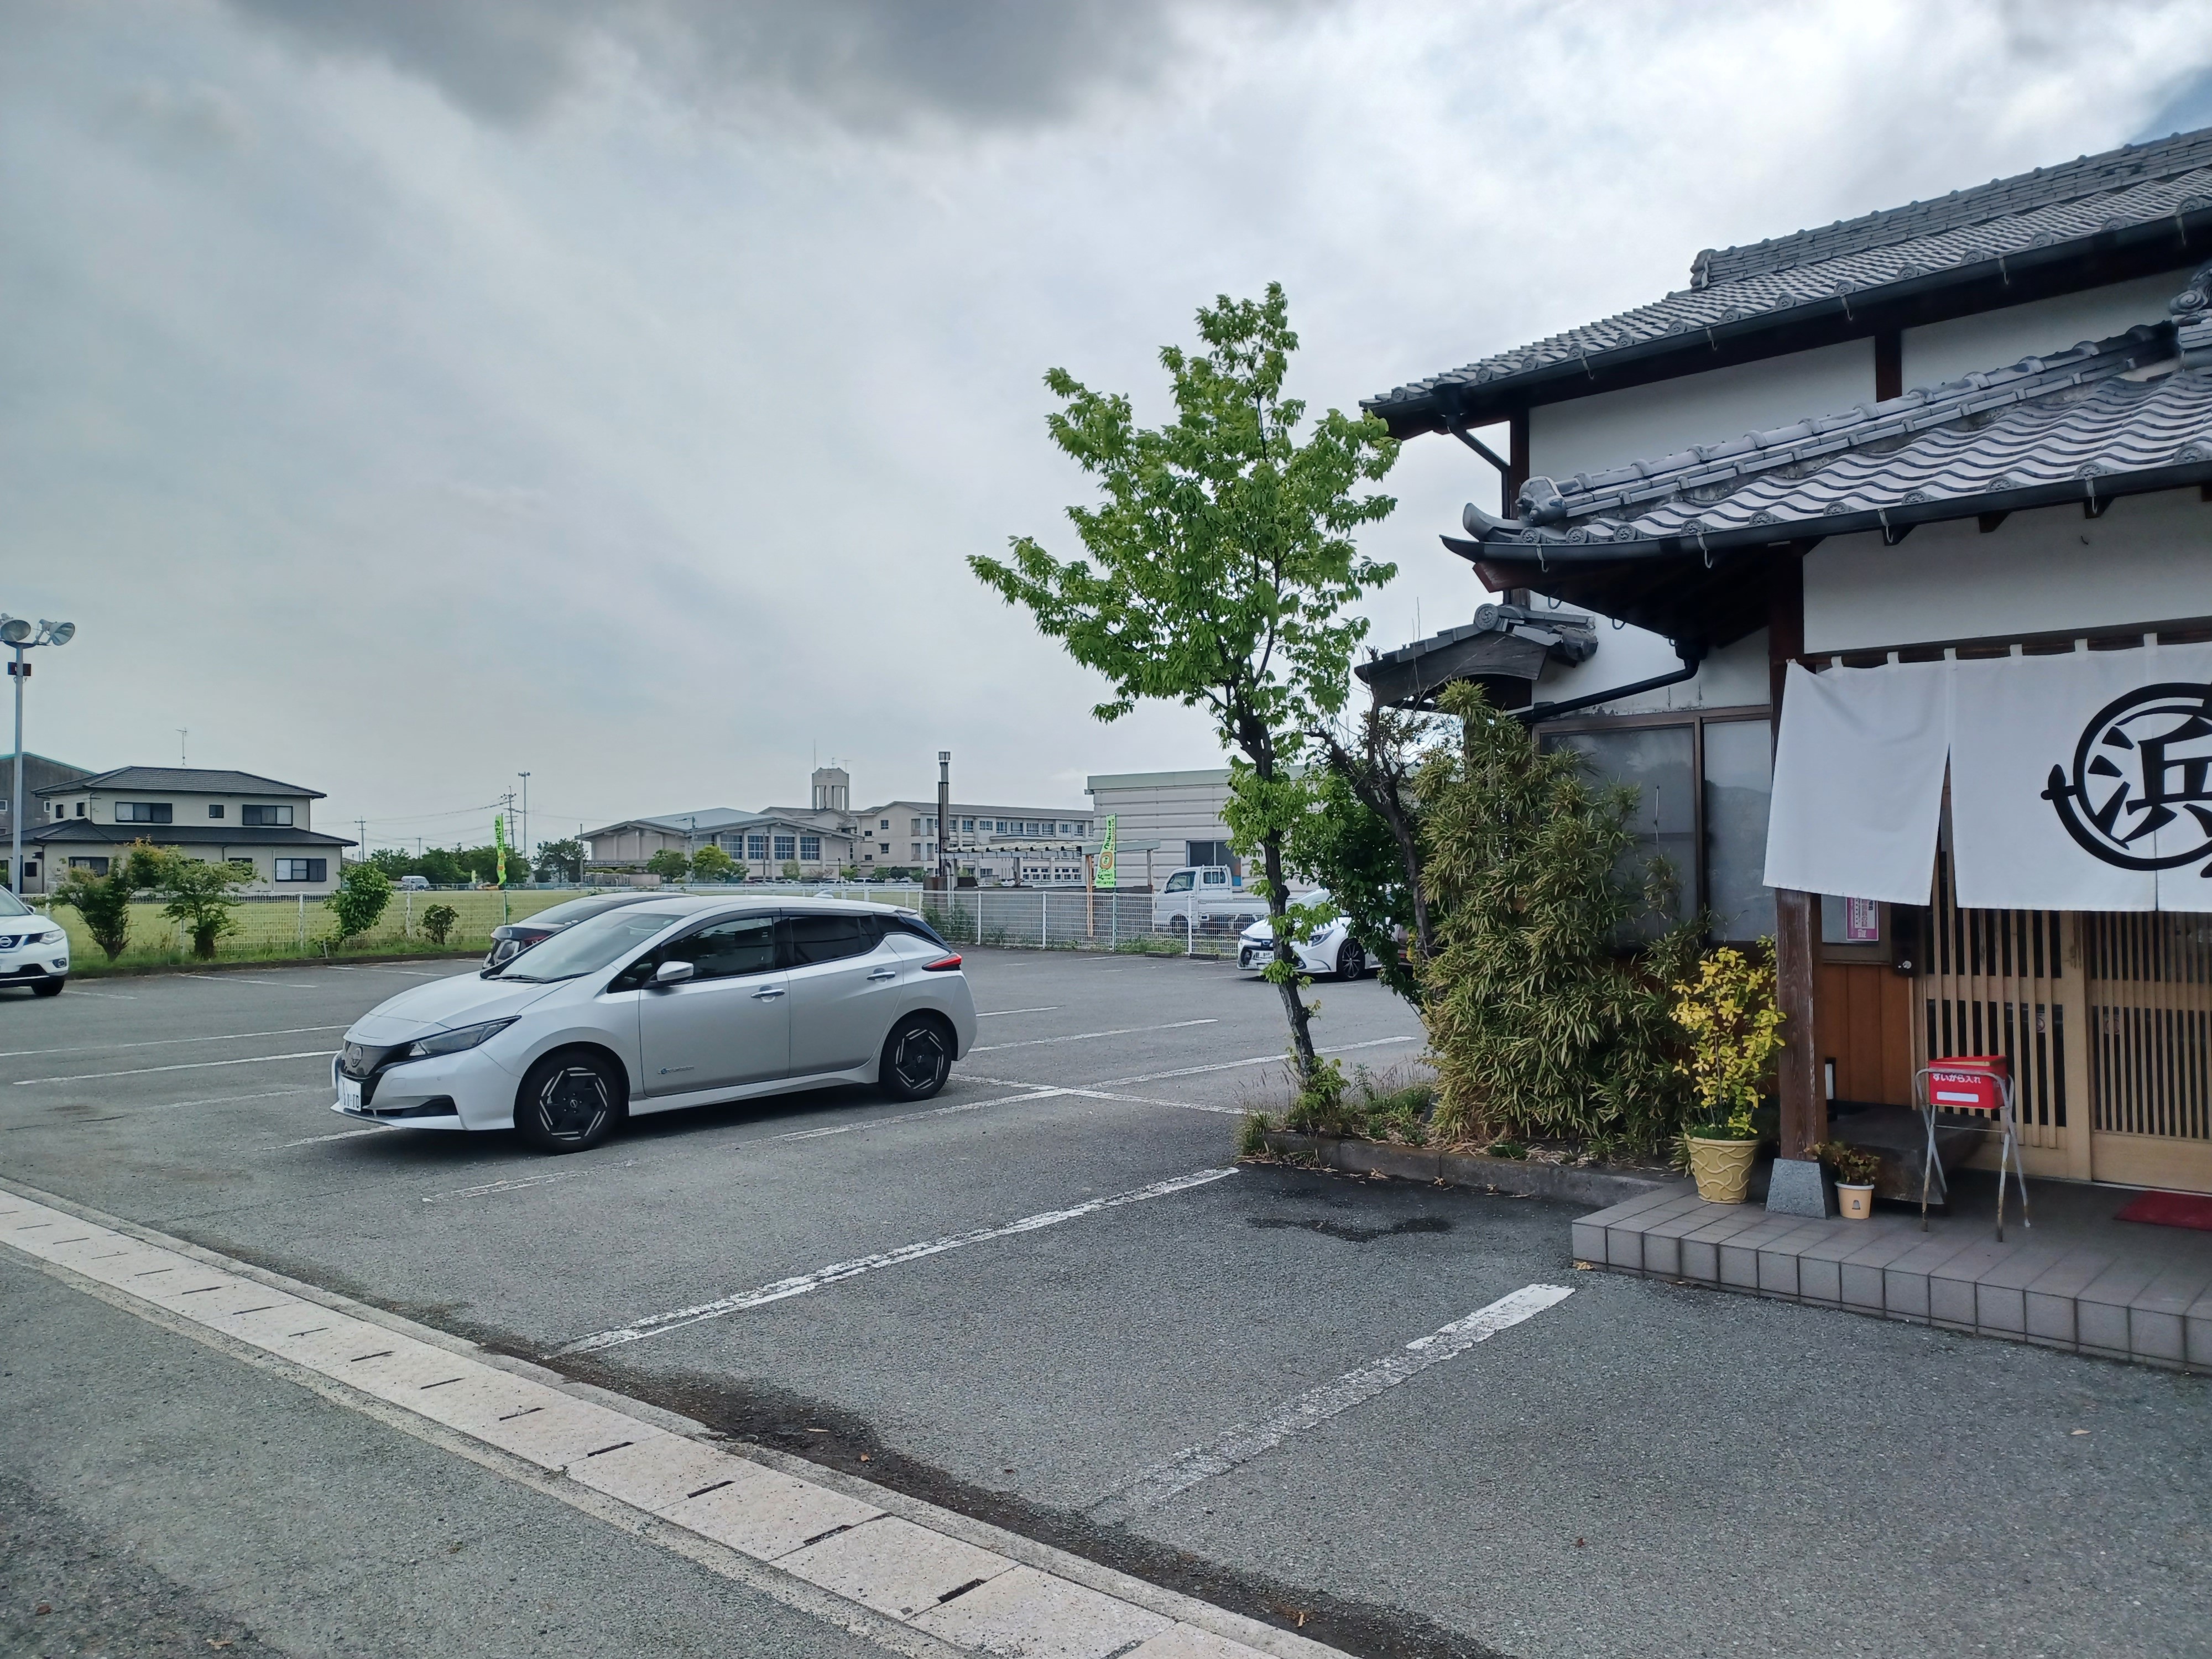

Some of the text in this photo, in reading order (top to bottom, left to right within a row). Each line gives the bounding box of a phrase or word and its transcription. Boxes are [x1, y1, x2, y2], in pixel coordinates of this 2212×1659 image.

[1932, 1073, 1981, 1084] すいがら入れ
